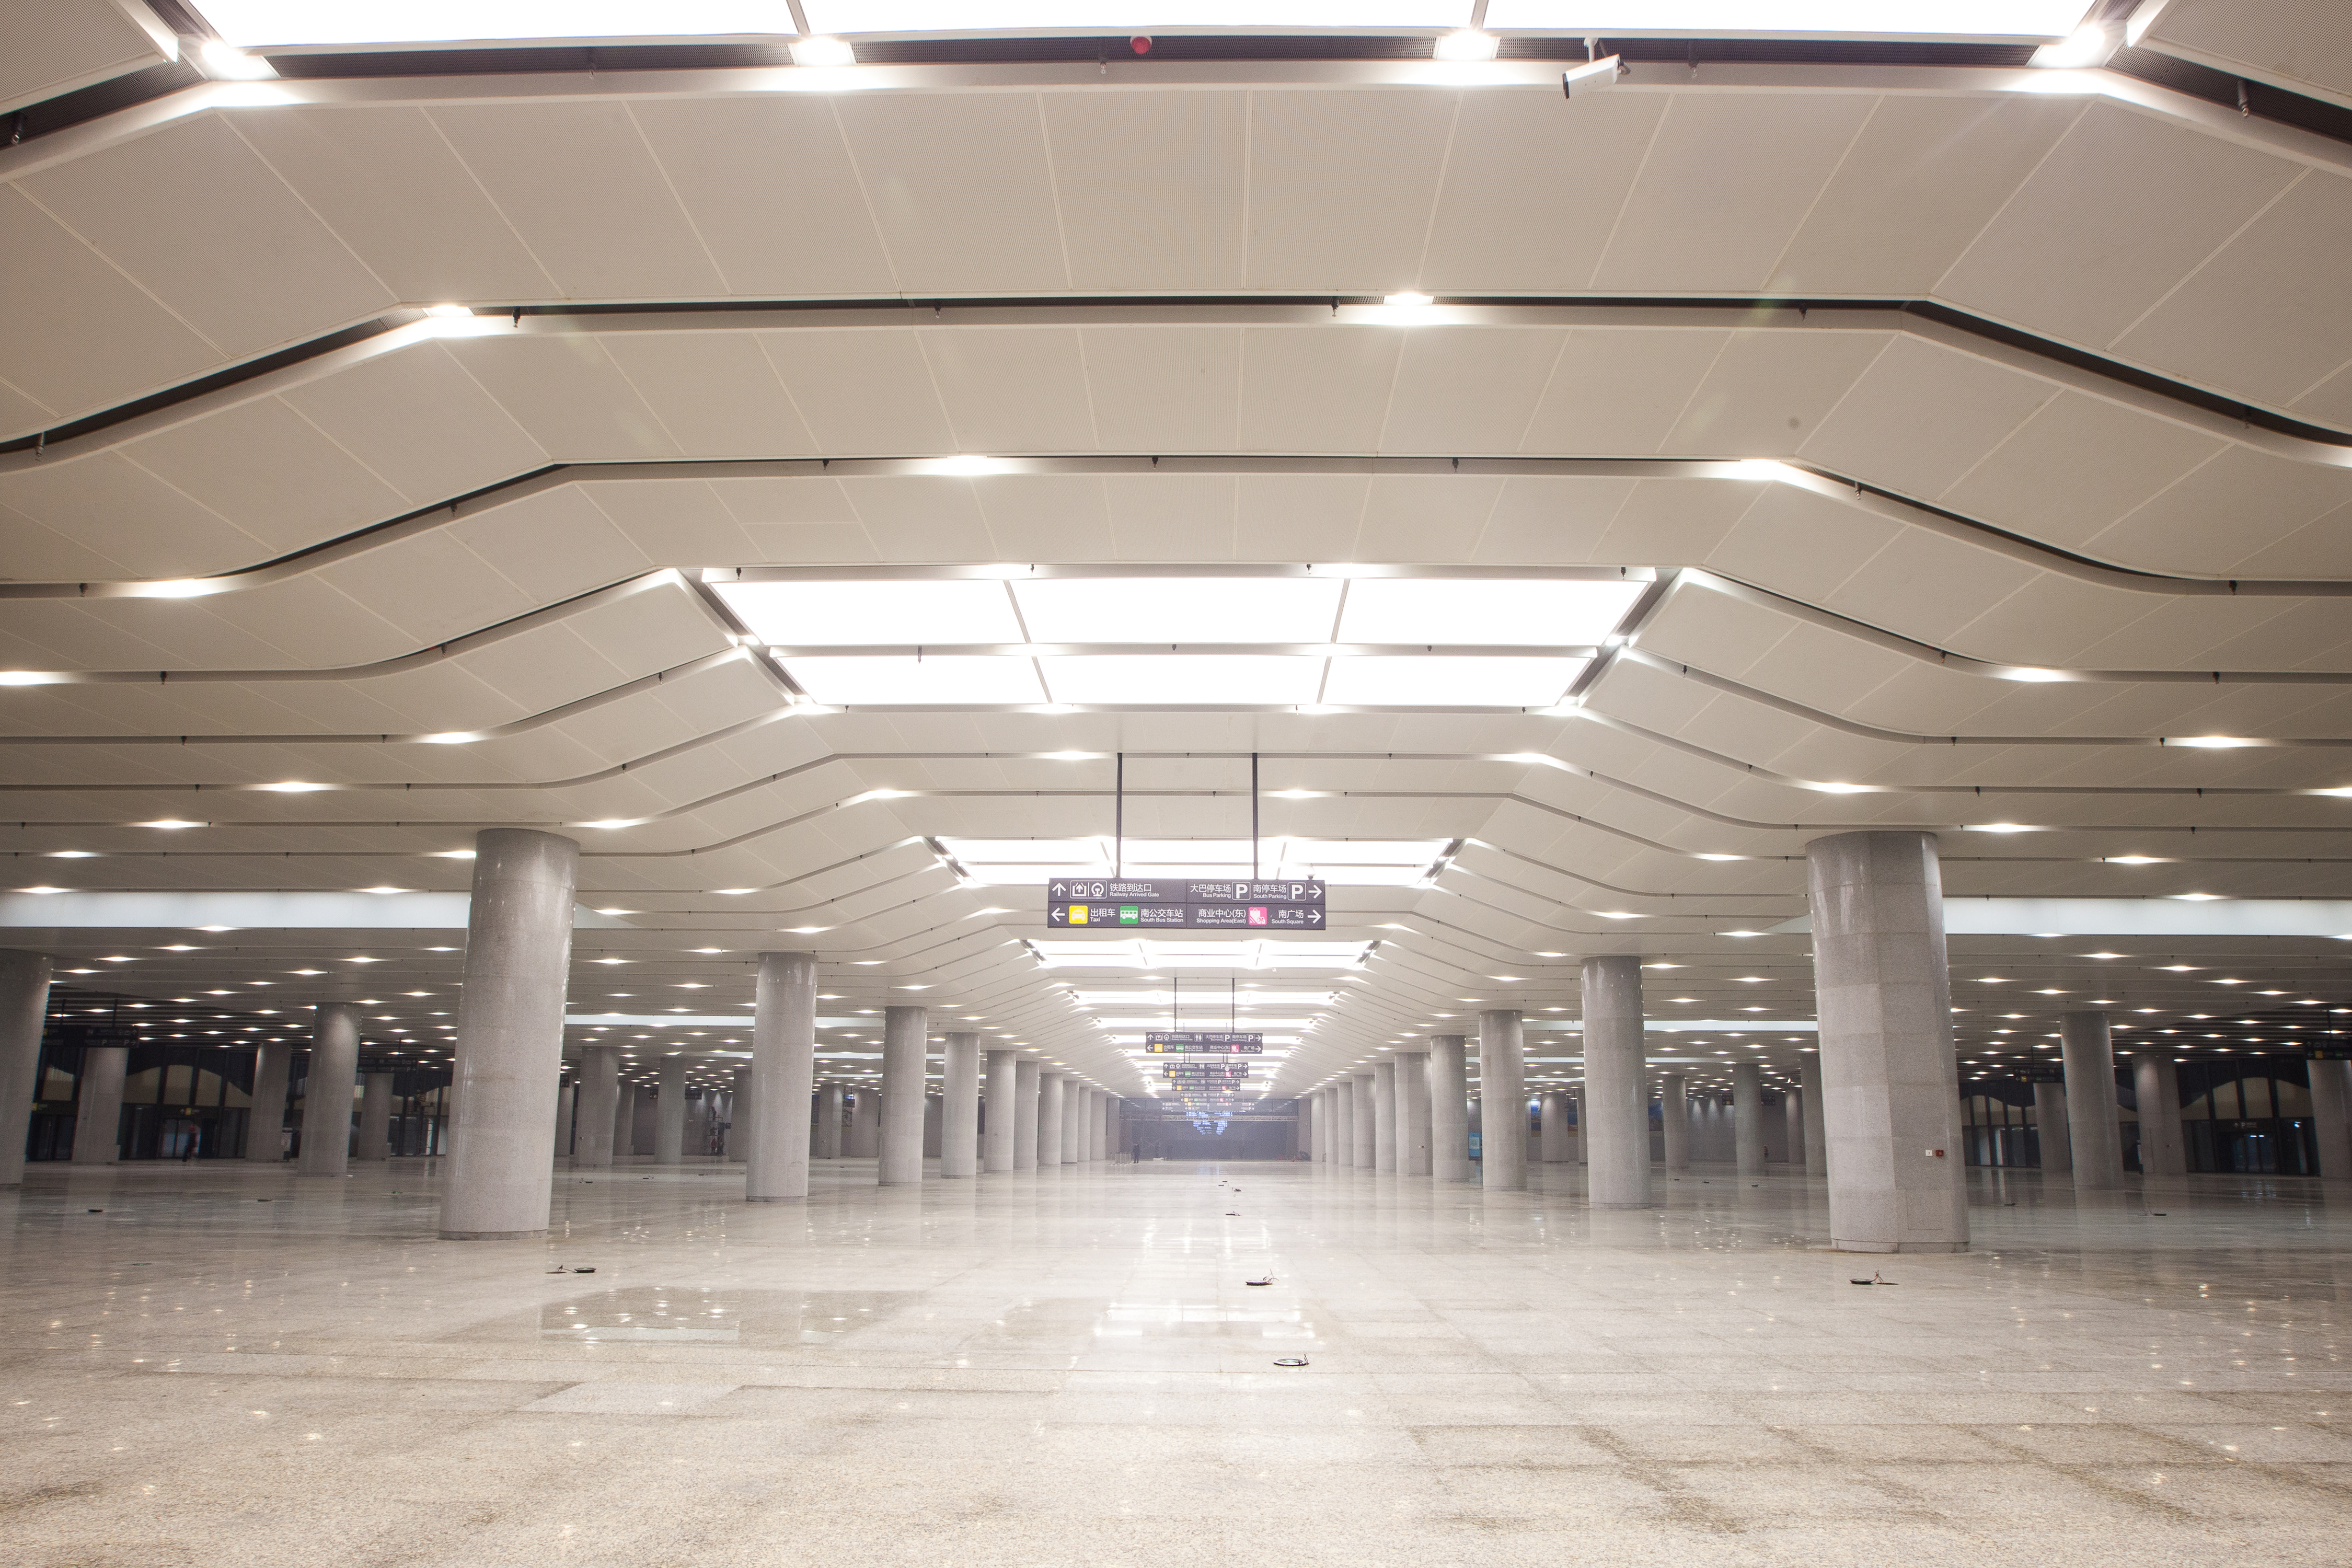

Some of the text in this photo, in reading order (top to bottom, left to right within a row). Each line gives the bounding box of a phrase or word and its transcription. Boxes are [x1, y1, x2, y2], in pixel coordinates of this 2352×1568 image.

[1110, 883, 1152, 892] 铁路到达口
[1190, 884, 1231, 893] 大巴停车场
[1236, 884, 1248, 899] P
[1253, 884, 1287, 893] 南停车场
[1292, 884, 1304, 900] P
[1090, 908, 1116, 917] 出租车
[1140, 908, 1183, 918] 南公交车站
[1198, 909, 1246, 918] 商业中心(东)
[1278, 910, 1304, 918] 南广场
